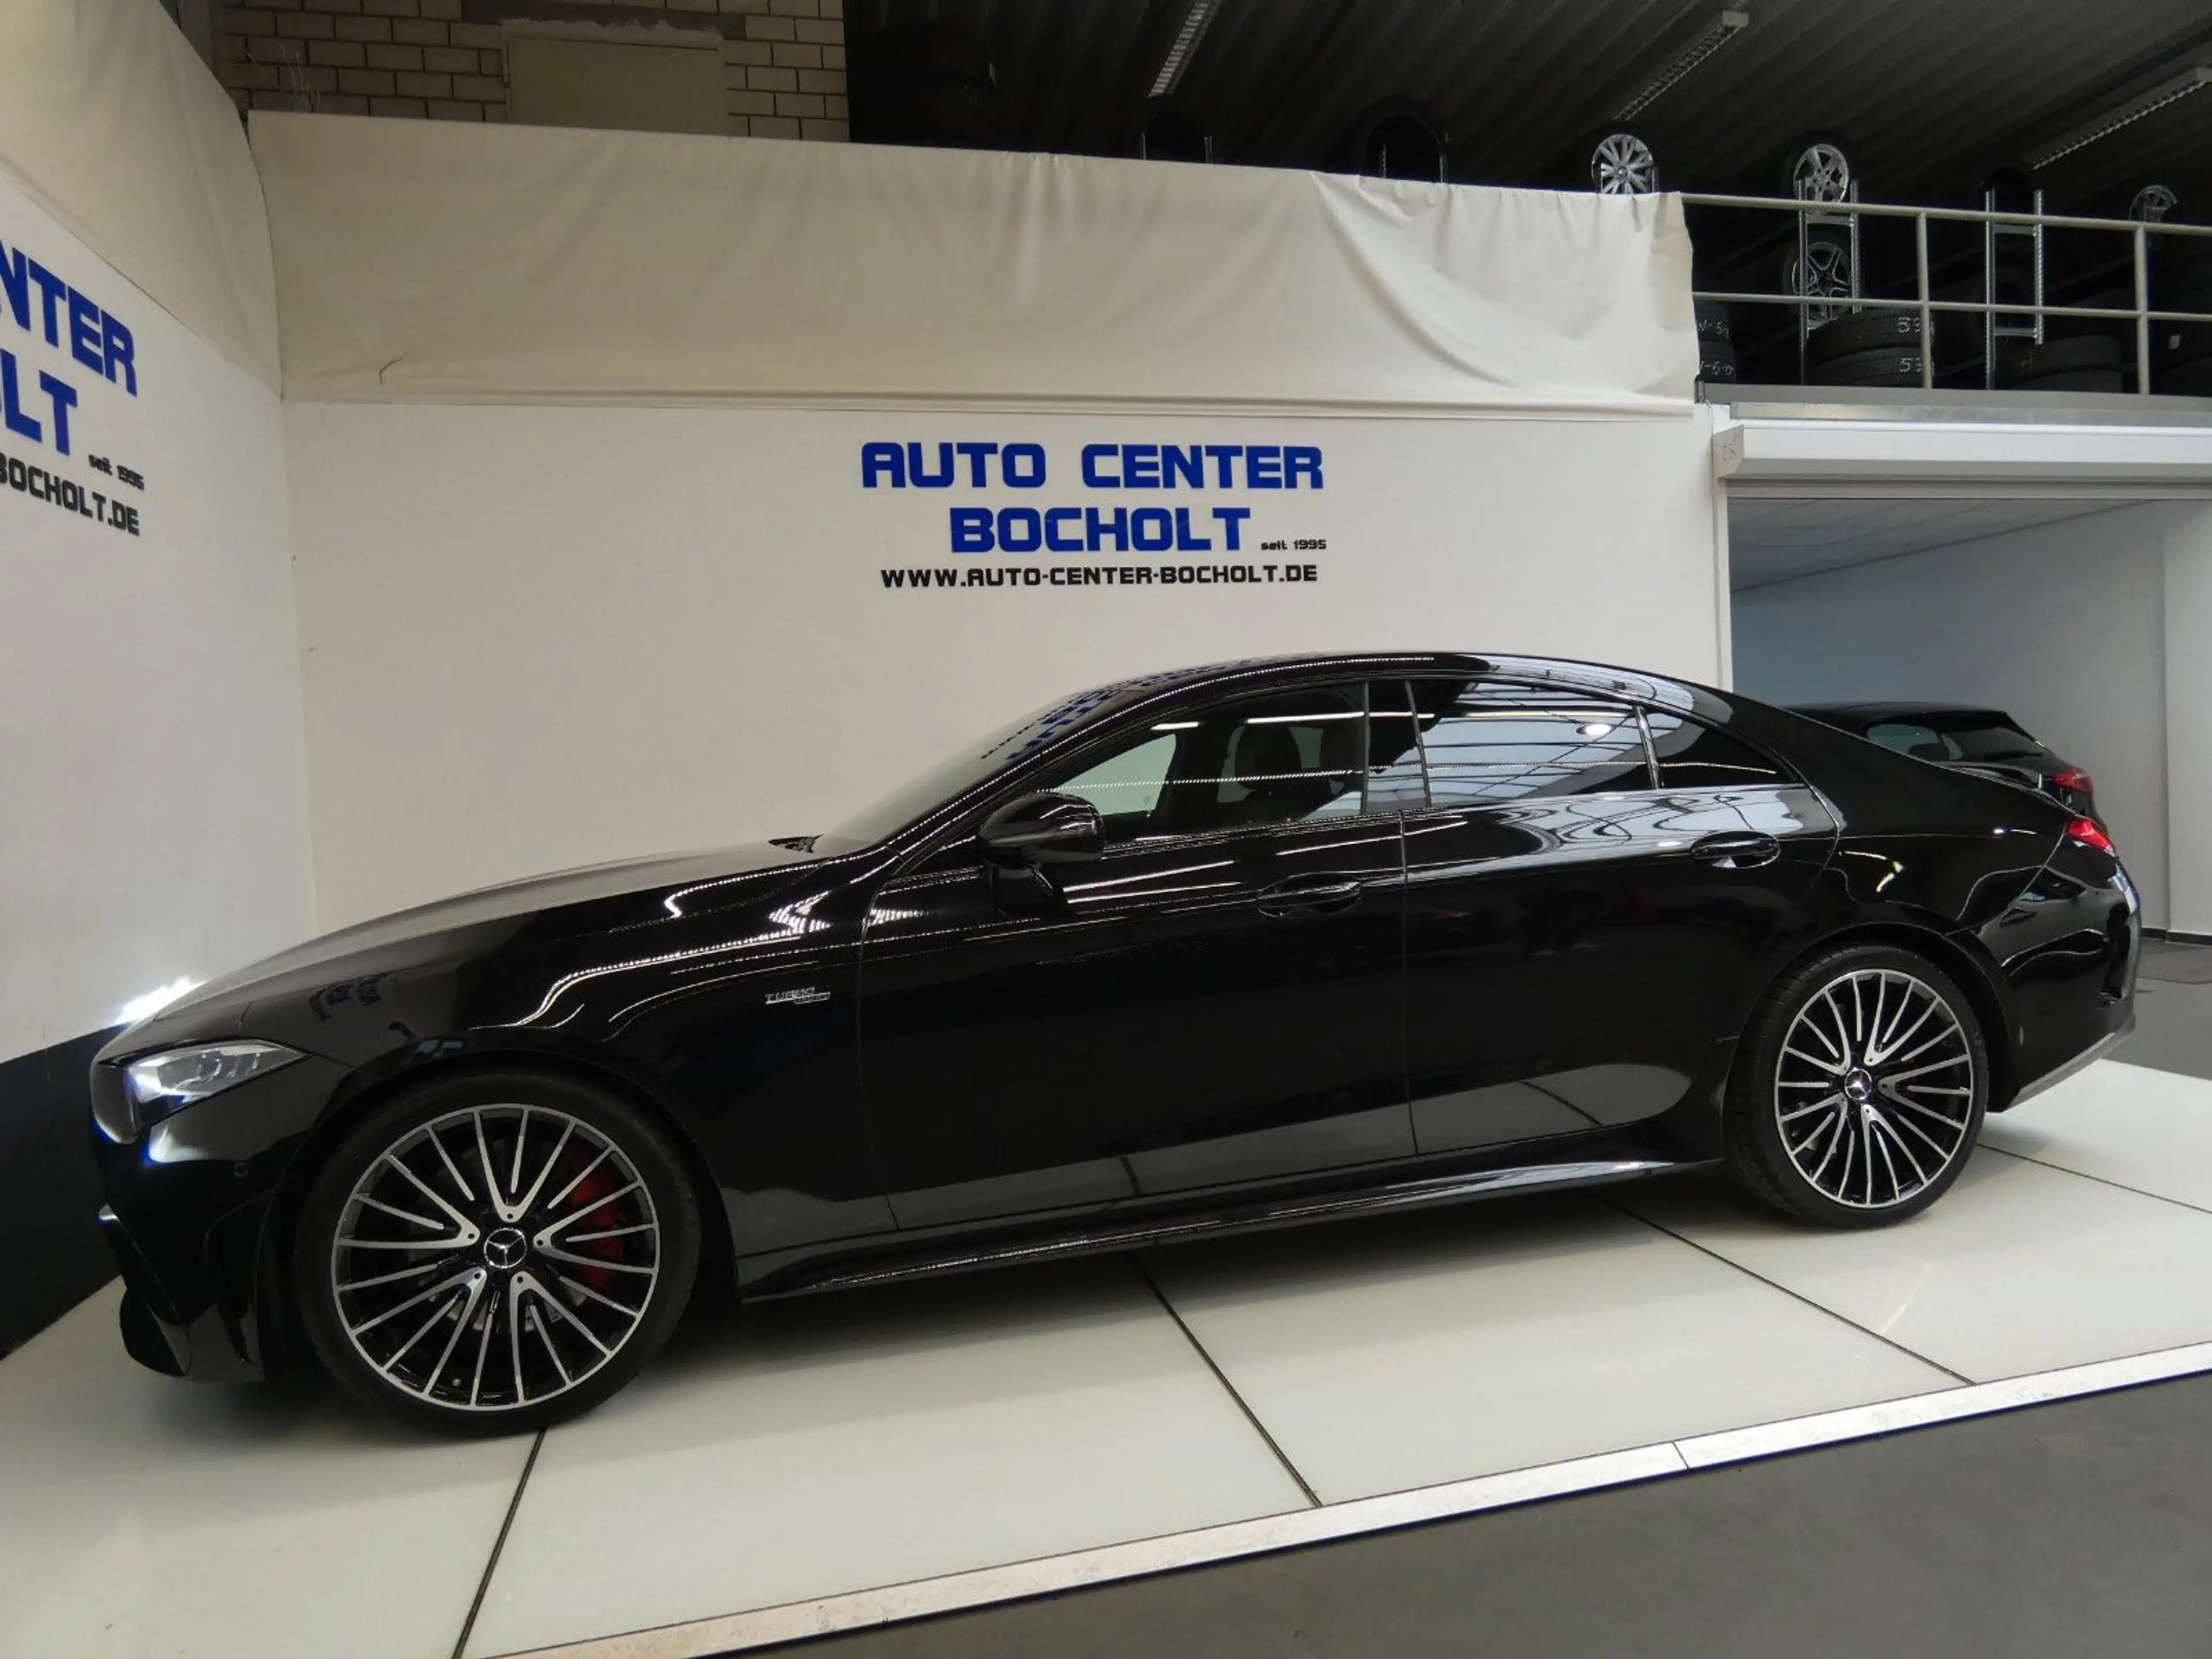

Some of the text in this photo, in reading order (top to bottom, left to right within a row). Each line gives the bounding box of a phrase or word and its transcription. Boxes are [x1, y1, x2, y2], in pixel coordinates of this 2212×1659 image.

[0, 239, 137, 397] NTER
[0, 349, 78, 456] LT
[862, 442, 1324, 490] AUTO CENTER
[950, 506, 1251, 553] BOCHOLT
[1260, 539, 1327, 551] seit 1995
[880, 564, 1318, 588] WWW.AUTO-CENTER-BOCHOLT.DE
